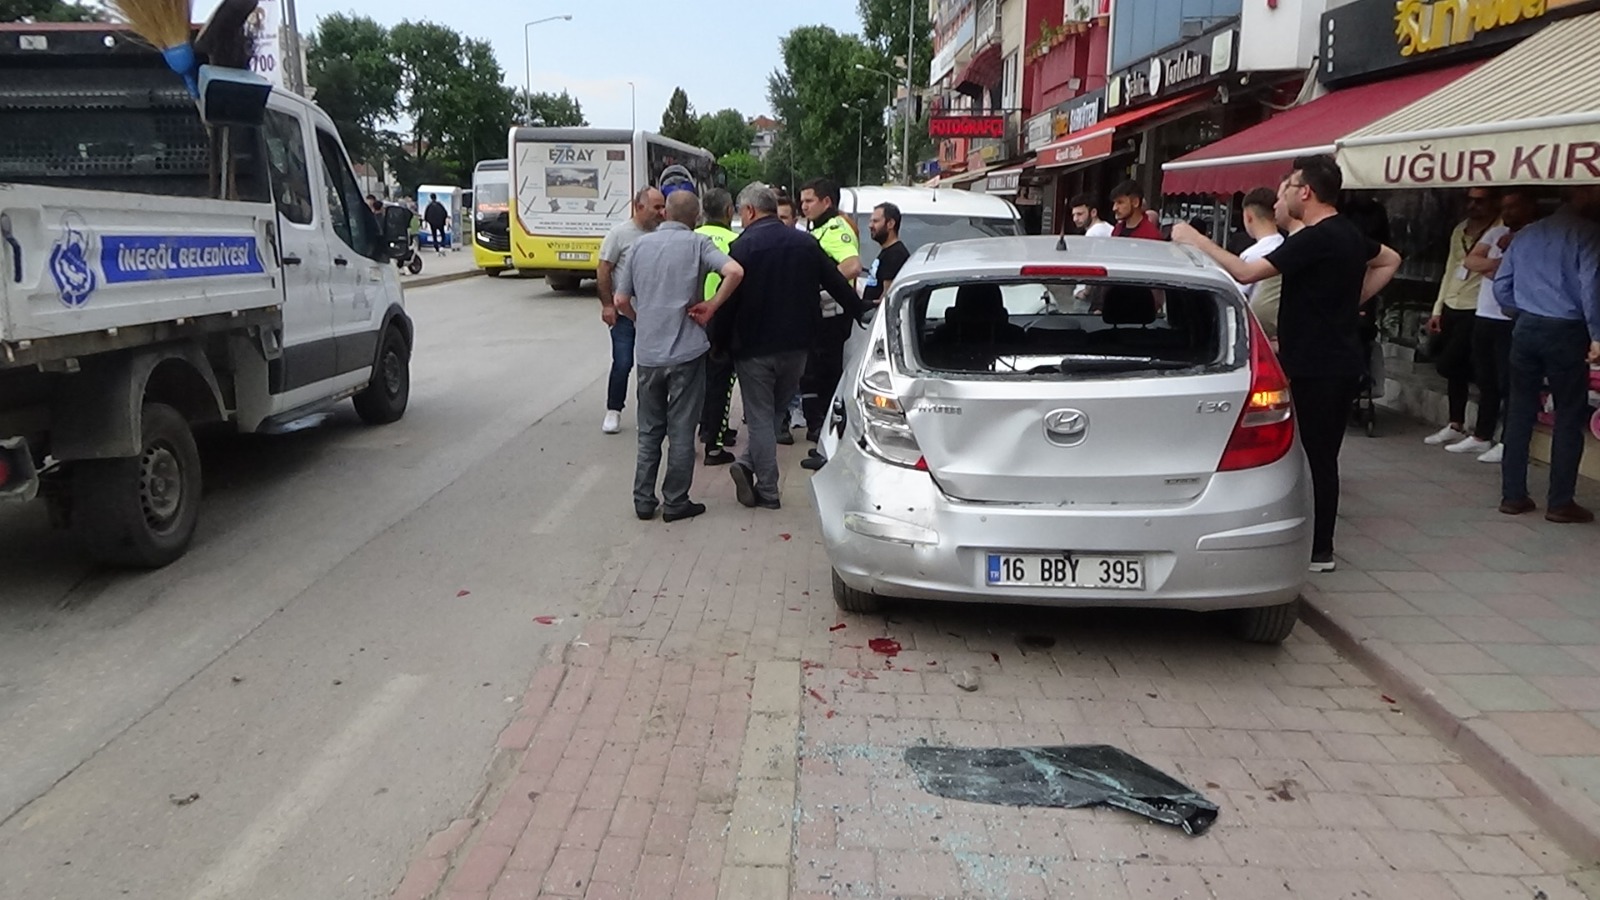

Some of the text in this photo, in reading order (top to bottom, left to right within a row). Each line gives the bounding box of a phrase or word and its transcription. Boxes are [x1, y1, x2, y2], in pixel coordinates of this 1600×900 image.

[549, 147, 595, 164] EZRAY
[1384, 142, 1600, 183] UĞUR KIR
[118, 242, 249, 271] İNEGÖL BELEDİYESİ
[1195, 400, 1232, 414] i30
[1002, 557, 1025, 581] 16
[1040, 558, 1080, 582] BBY
[1098, 560, 1139, 584] 395
